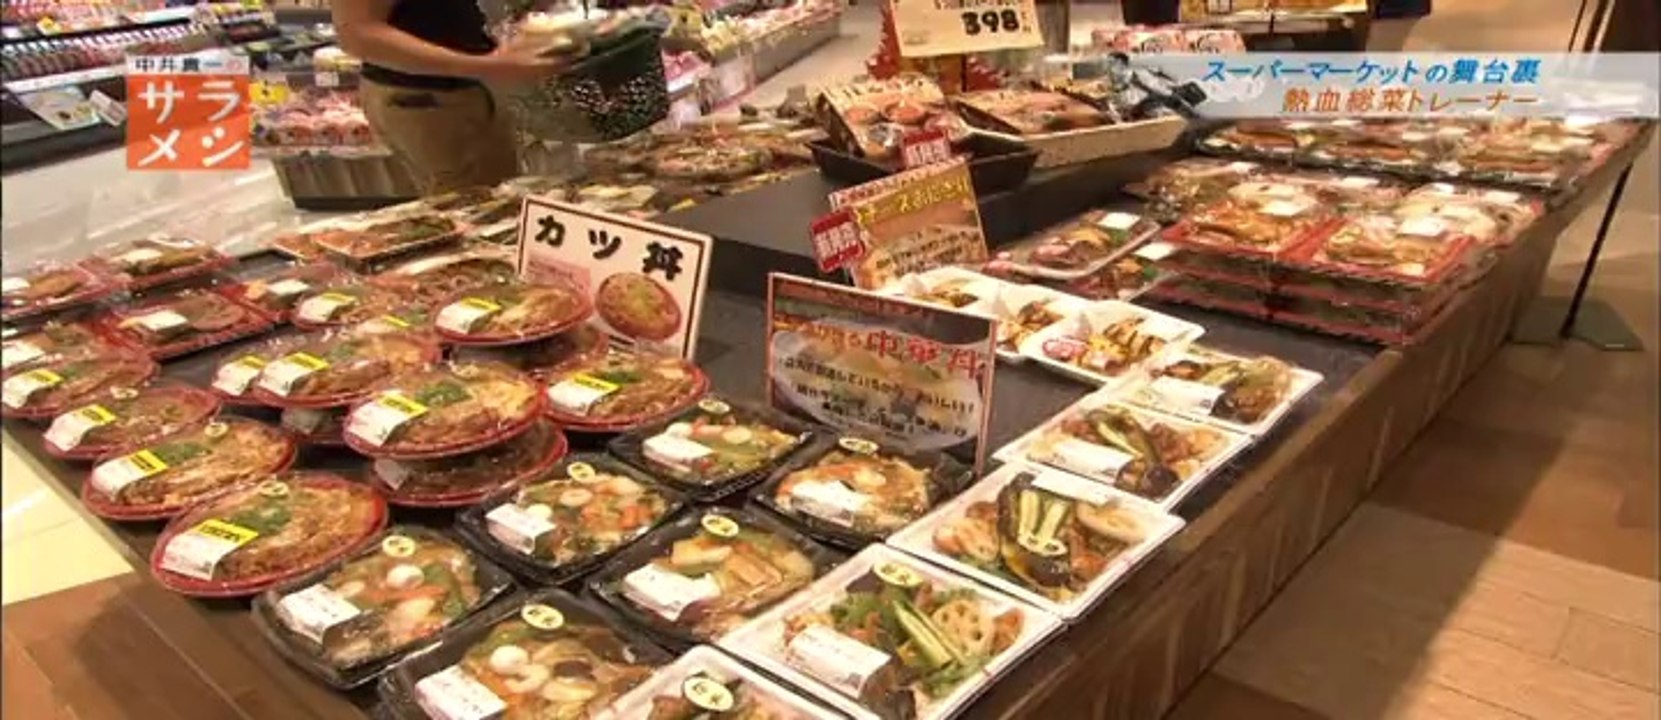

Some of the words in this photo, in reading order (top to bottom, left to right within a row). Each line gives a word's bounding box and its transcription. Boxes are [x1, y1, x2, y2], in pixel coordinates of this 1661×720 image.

[961, 9, 1019, 35] 398
[534, 215, 684, 282] カツ丼
